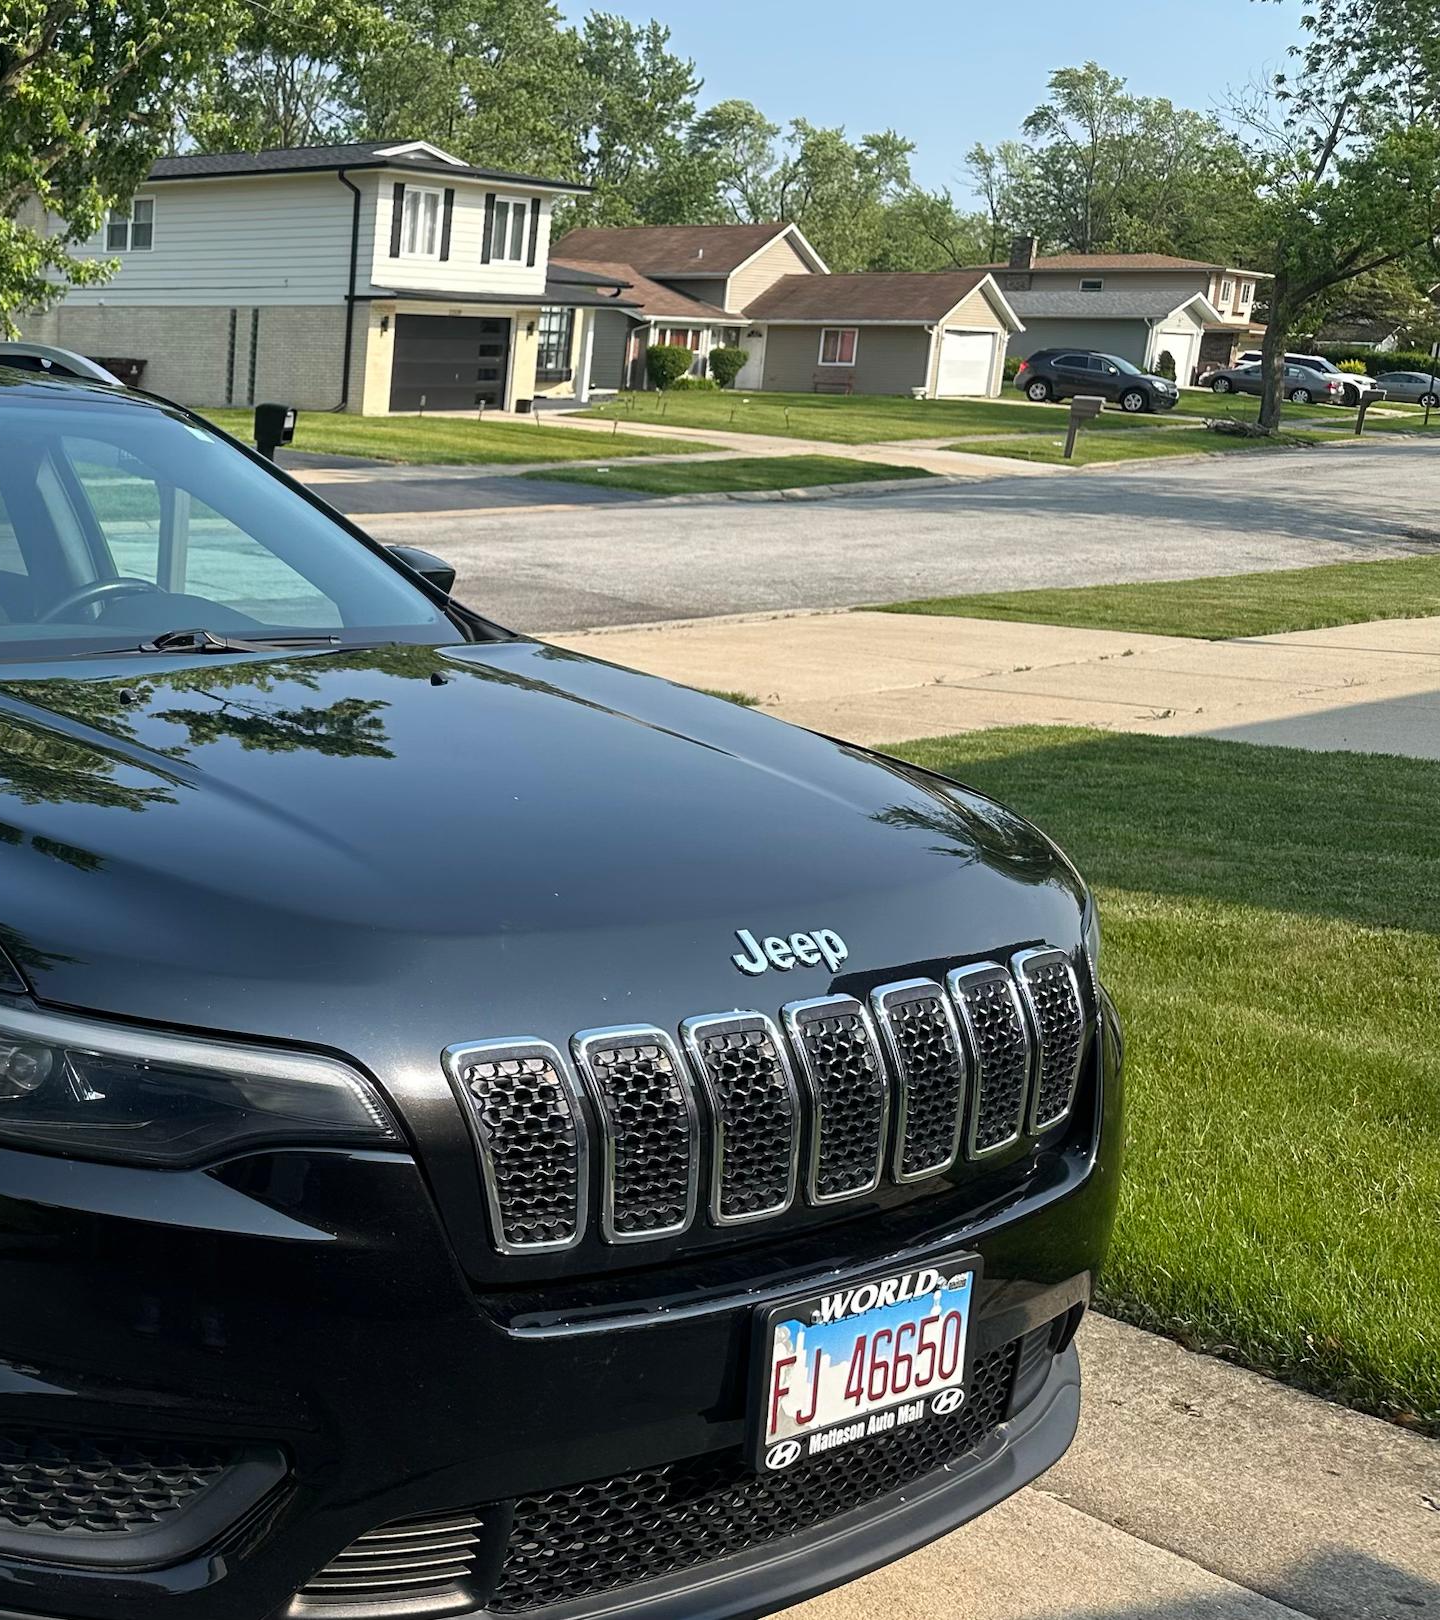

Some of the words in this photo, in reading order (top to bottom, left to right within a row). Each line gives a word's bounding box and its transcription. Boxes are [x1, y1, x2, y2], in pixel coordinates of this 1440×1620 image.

[730, 929, 848, 976] Jeep
[821, 1269, 938, 1323] WORLD
[770, 1348, 822, 1436] FJ
[844, 1310, 961, 1407] 46650
[808, 1417, 865, 1455] Matteson
[867, 1412, 895, 1435] Auto
[897, 1400, 925, 1425] Mall
